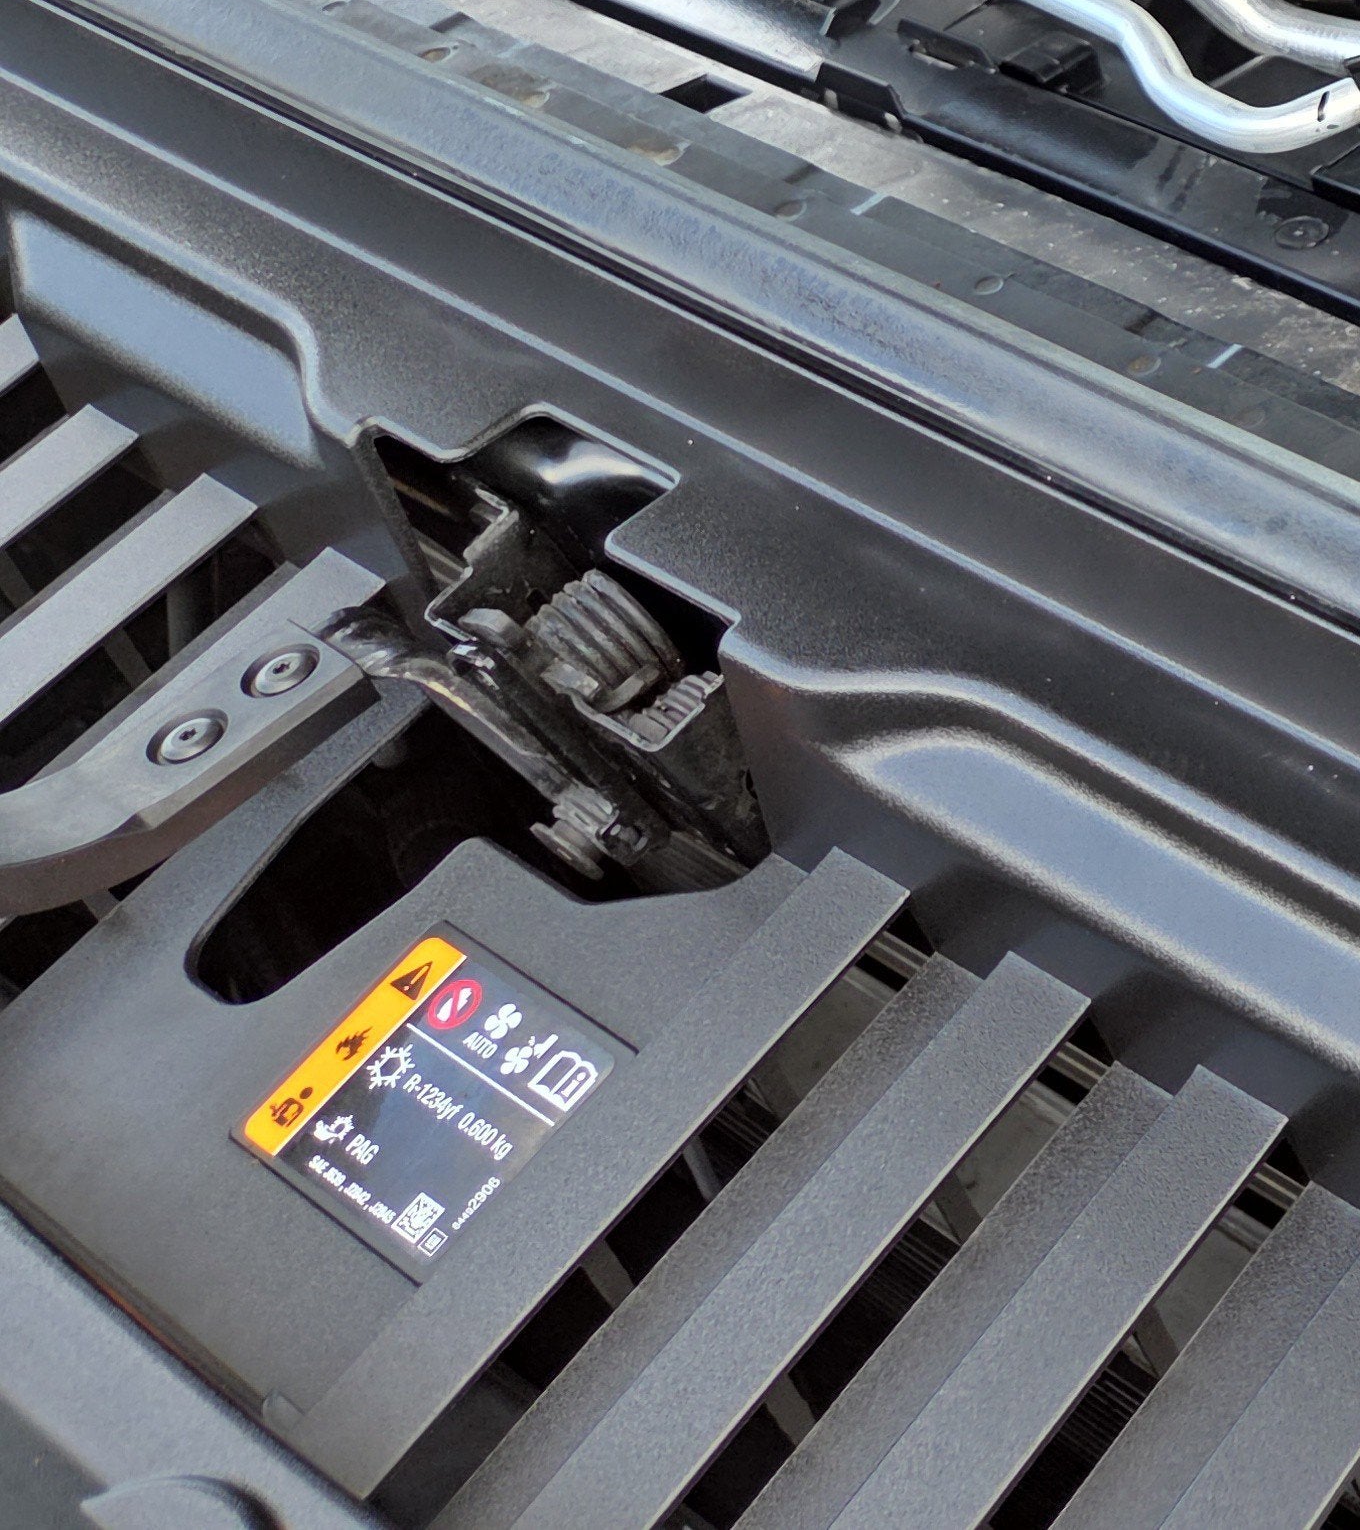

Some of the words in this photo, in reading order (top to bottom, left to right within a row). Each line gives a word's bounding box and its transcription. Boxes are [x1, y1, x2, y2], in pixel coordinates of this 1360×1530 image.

[462, 1032, 498, 1059] AUTO
[403, 1073, 463, 1120] R-1234yf
[457, 1112, 499, 1146] 0.600
[489, 1133, 513, 1160] kg
[345, 1134, 380, 1165] PAG
[309, 1155, 330, 1174] SAE
